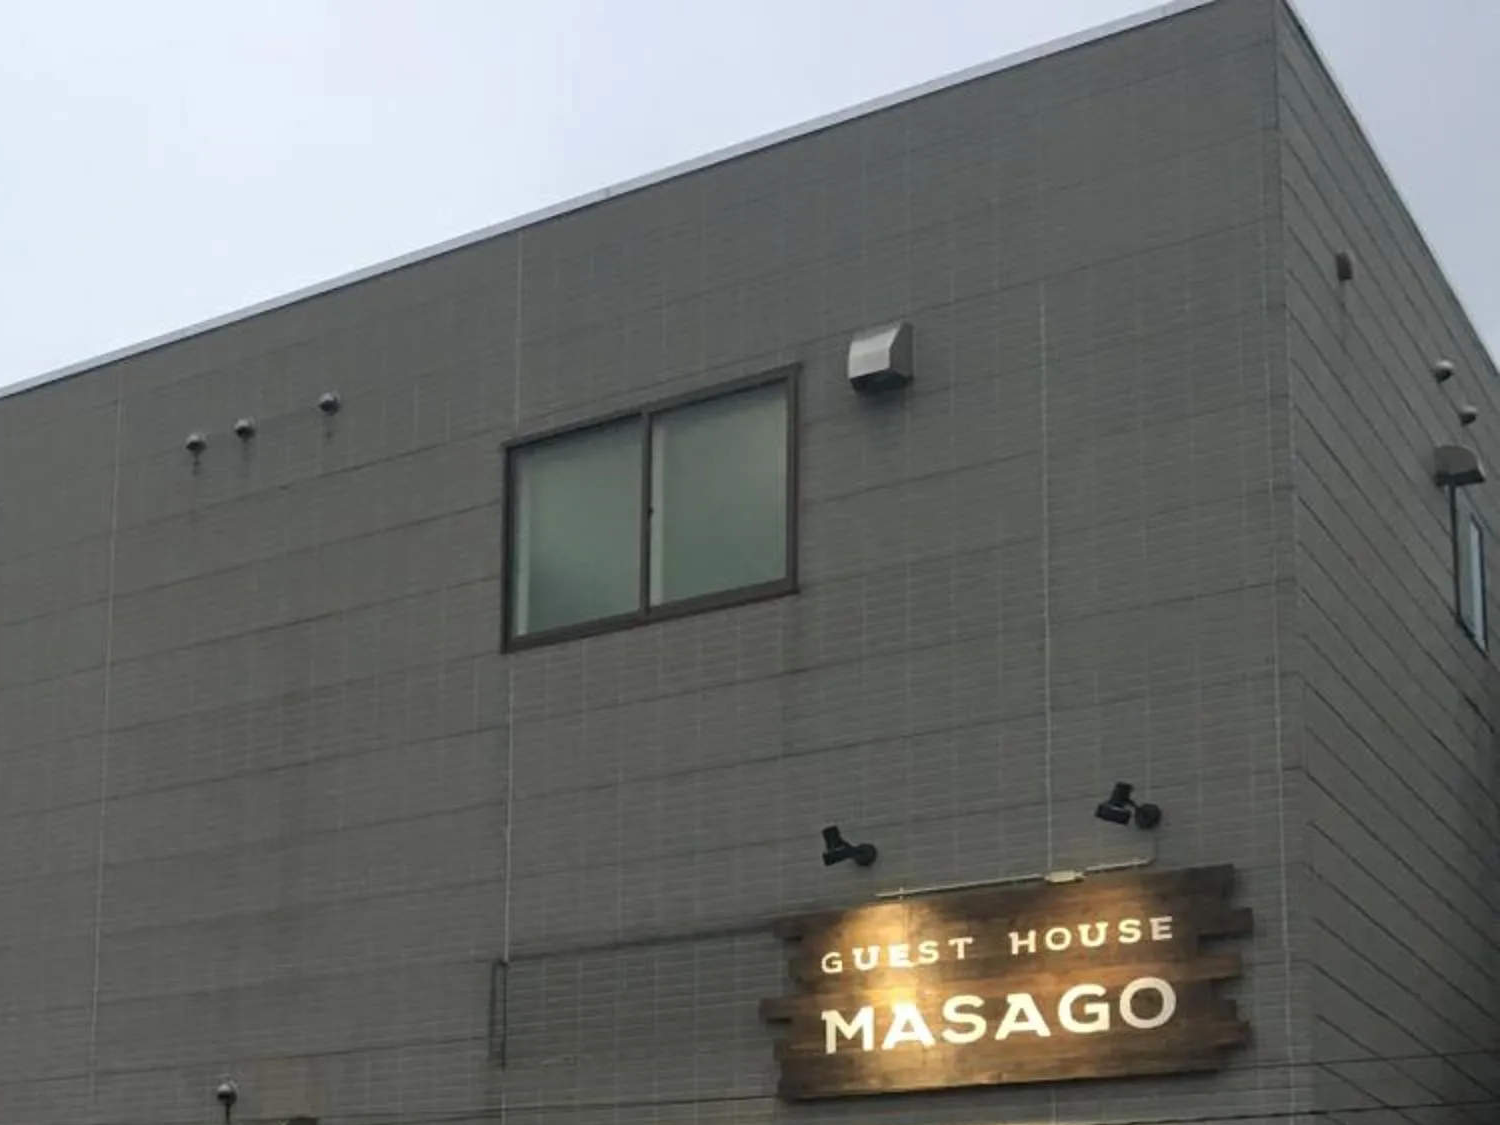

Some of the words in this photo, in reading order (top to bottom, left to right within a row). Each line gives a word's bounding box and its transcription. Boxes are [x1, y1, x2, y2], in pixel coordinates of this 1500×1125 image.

[820, 936, 974, 975] GUEST
[1008, 915, 1174, 956] HOUSE
[820, 976, 1177, 1055] MASAGO
